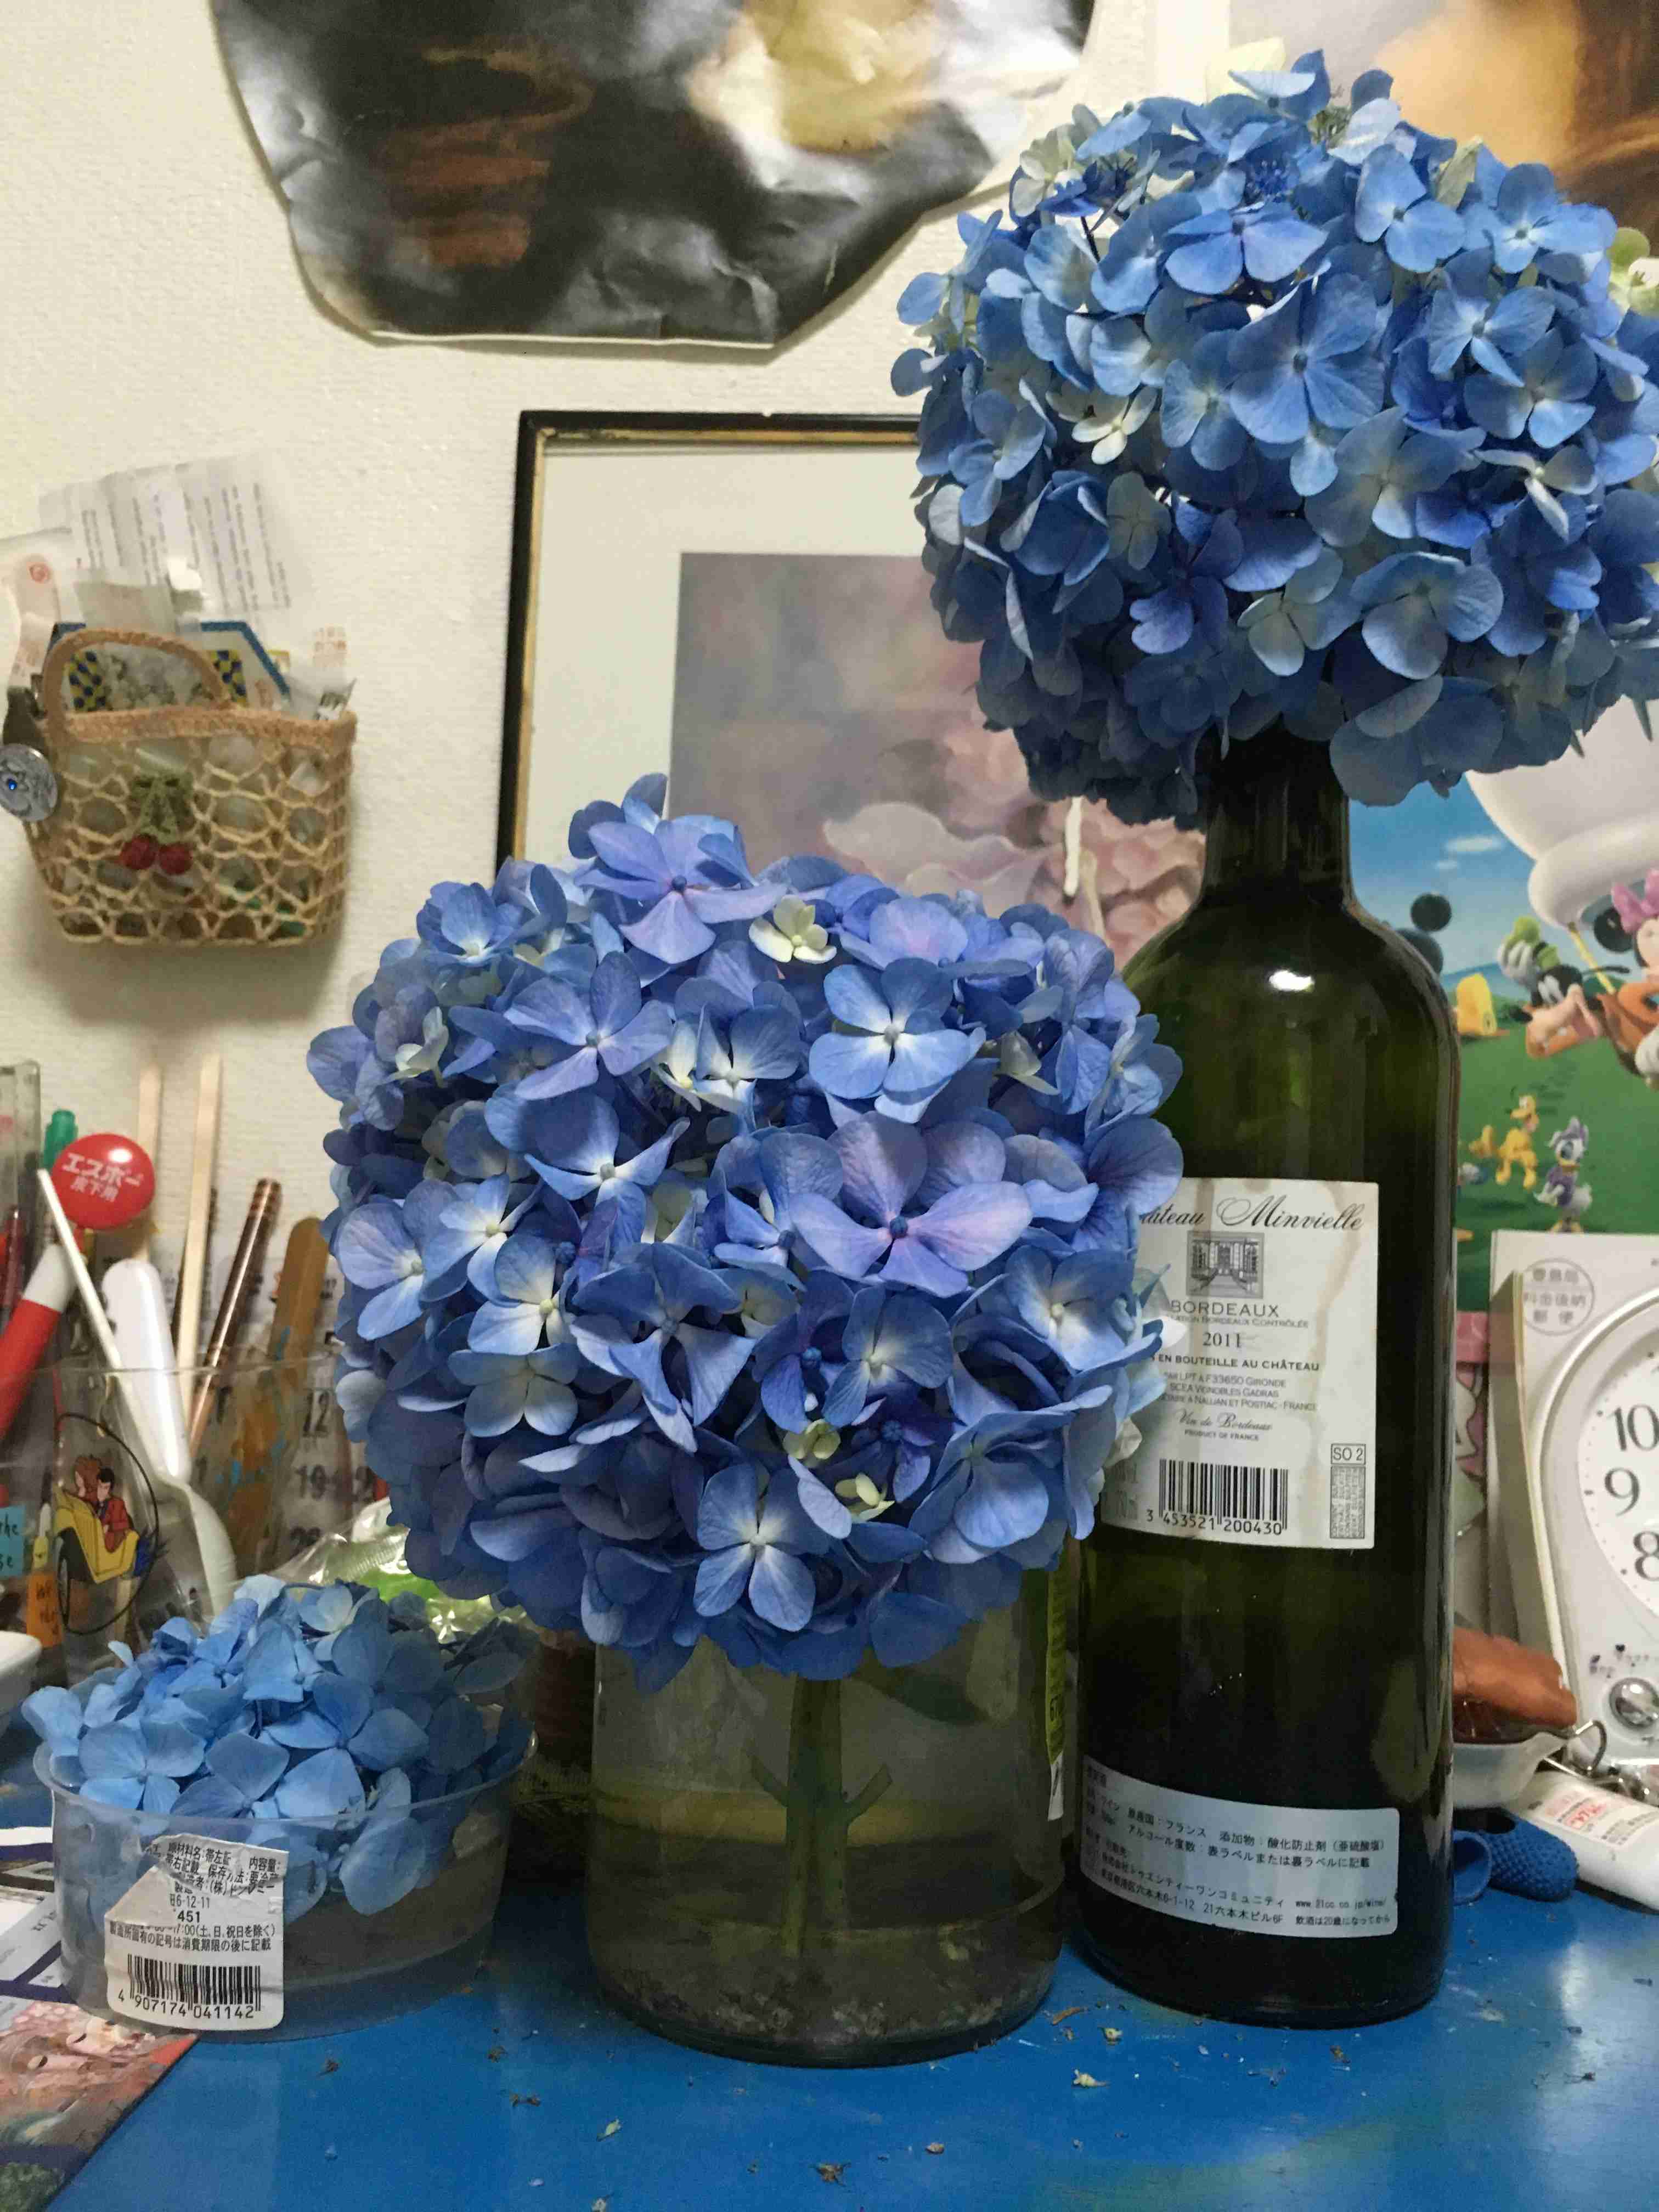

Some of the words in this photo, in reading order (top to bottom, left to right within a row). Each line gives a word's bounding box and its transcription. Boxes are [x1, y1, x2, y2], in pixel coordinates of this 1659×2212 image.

[1170, 1299, 1279, 1317] BORDEAUX
[1159, 1353, 1172, 1362] EN
[1175, 1355, 1238, 1367] BOUTEILLE
[1242, 1359, 1258, 1368] AU
[1262, 1359, 1319, 1371] CHÂTEAU
[1607, 1404, 1659, 1451] 10
[1333, 1447, 1352, 1461] SO
[1356, 1447, 1363, 1461] 2
[1604, 1467, 1640, 1517] 9
[1146, 1509, 1154, 1522] 3
[1163, 1513, 1215, 1531] 453521
[1224, 1519, 1282, 1536] 200430
[177, 1911, 200, 1922] 451
[118, 1989, 125, 2002] 4
[135, 1994, 187, 2017] 907174
[193, 2006, 253, 2019] 041142
